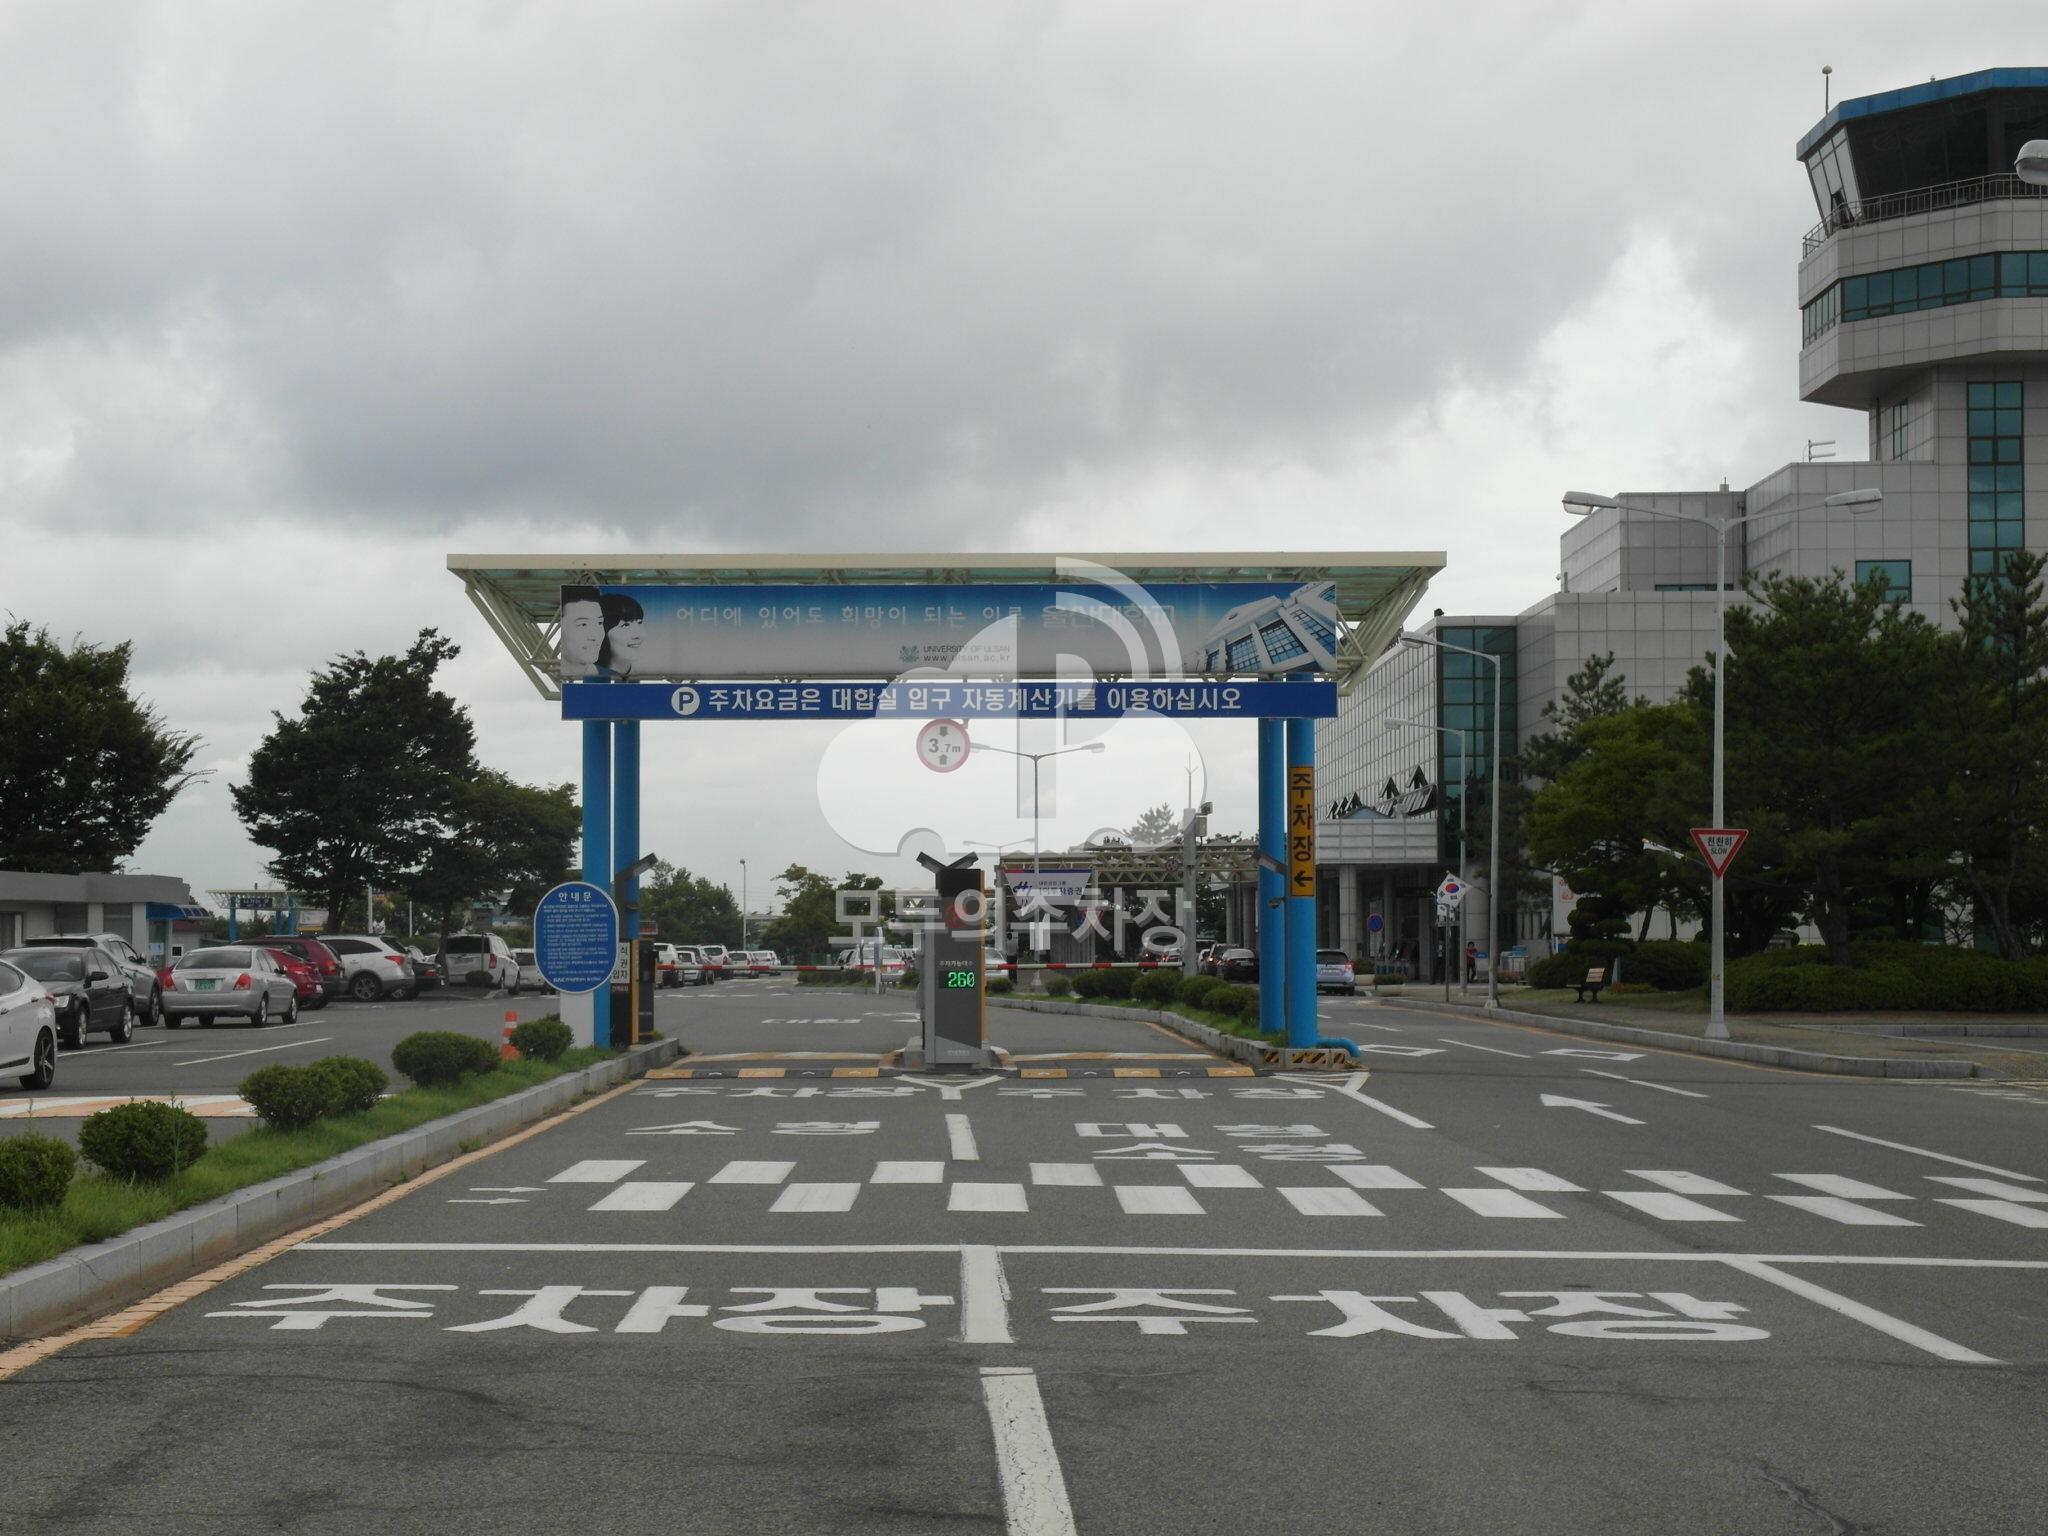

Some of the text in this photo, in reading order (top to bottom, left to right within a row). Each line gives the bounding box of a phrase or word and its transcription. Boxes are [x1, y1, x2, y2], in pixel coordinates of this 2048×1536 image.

[676, 606, 742, 628] 어디에
[758, 606, 825, 629] 있어도
[841, 606, 907, 630] 희망이
[924, 606, 968, 628] 되는
[971, 645, 982, 653] OF
[984, 645, 1010, 653] ULSAN
[709, 687, 1242, 712] 주차요금은 대합실 입구 자동계산기를 이용하십시오
[1291, 772, 1313, 863] 주차장
[1707, 836, 1732, 847] 천천히
[1711, 847, 1728, 855] SLOW
[948, 972, 975, 988] 260
[203, 1283, 957, 1336] 주차장
[1039, 1286, 1771, 1342] 주차장
